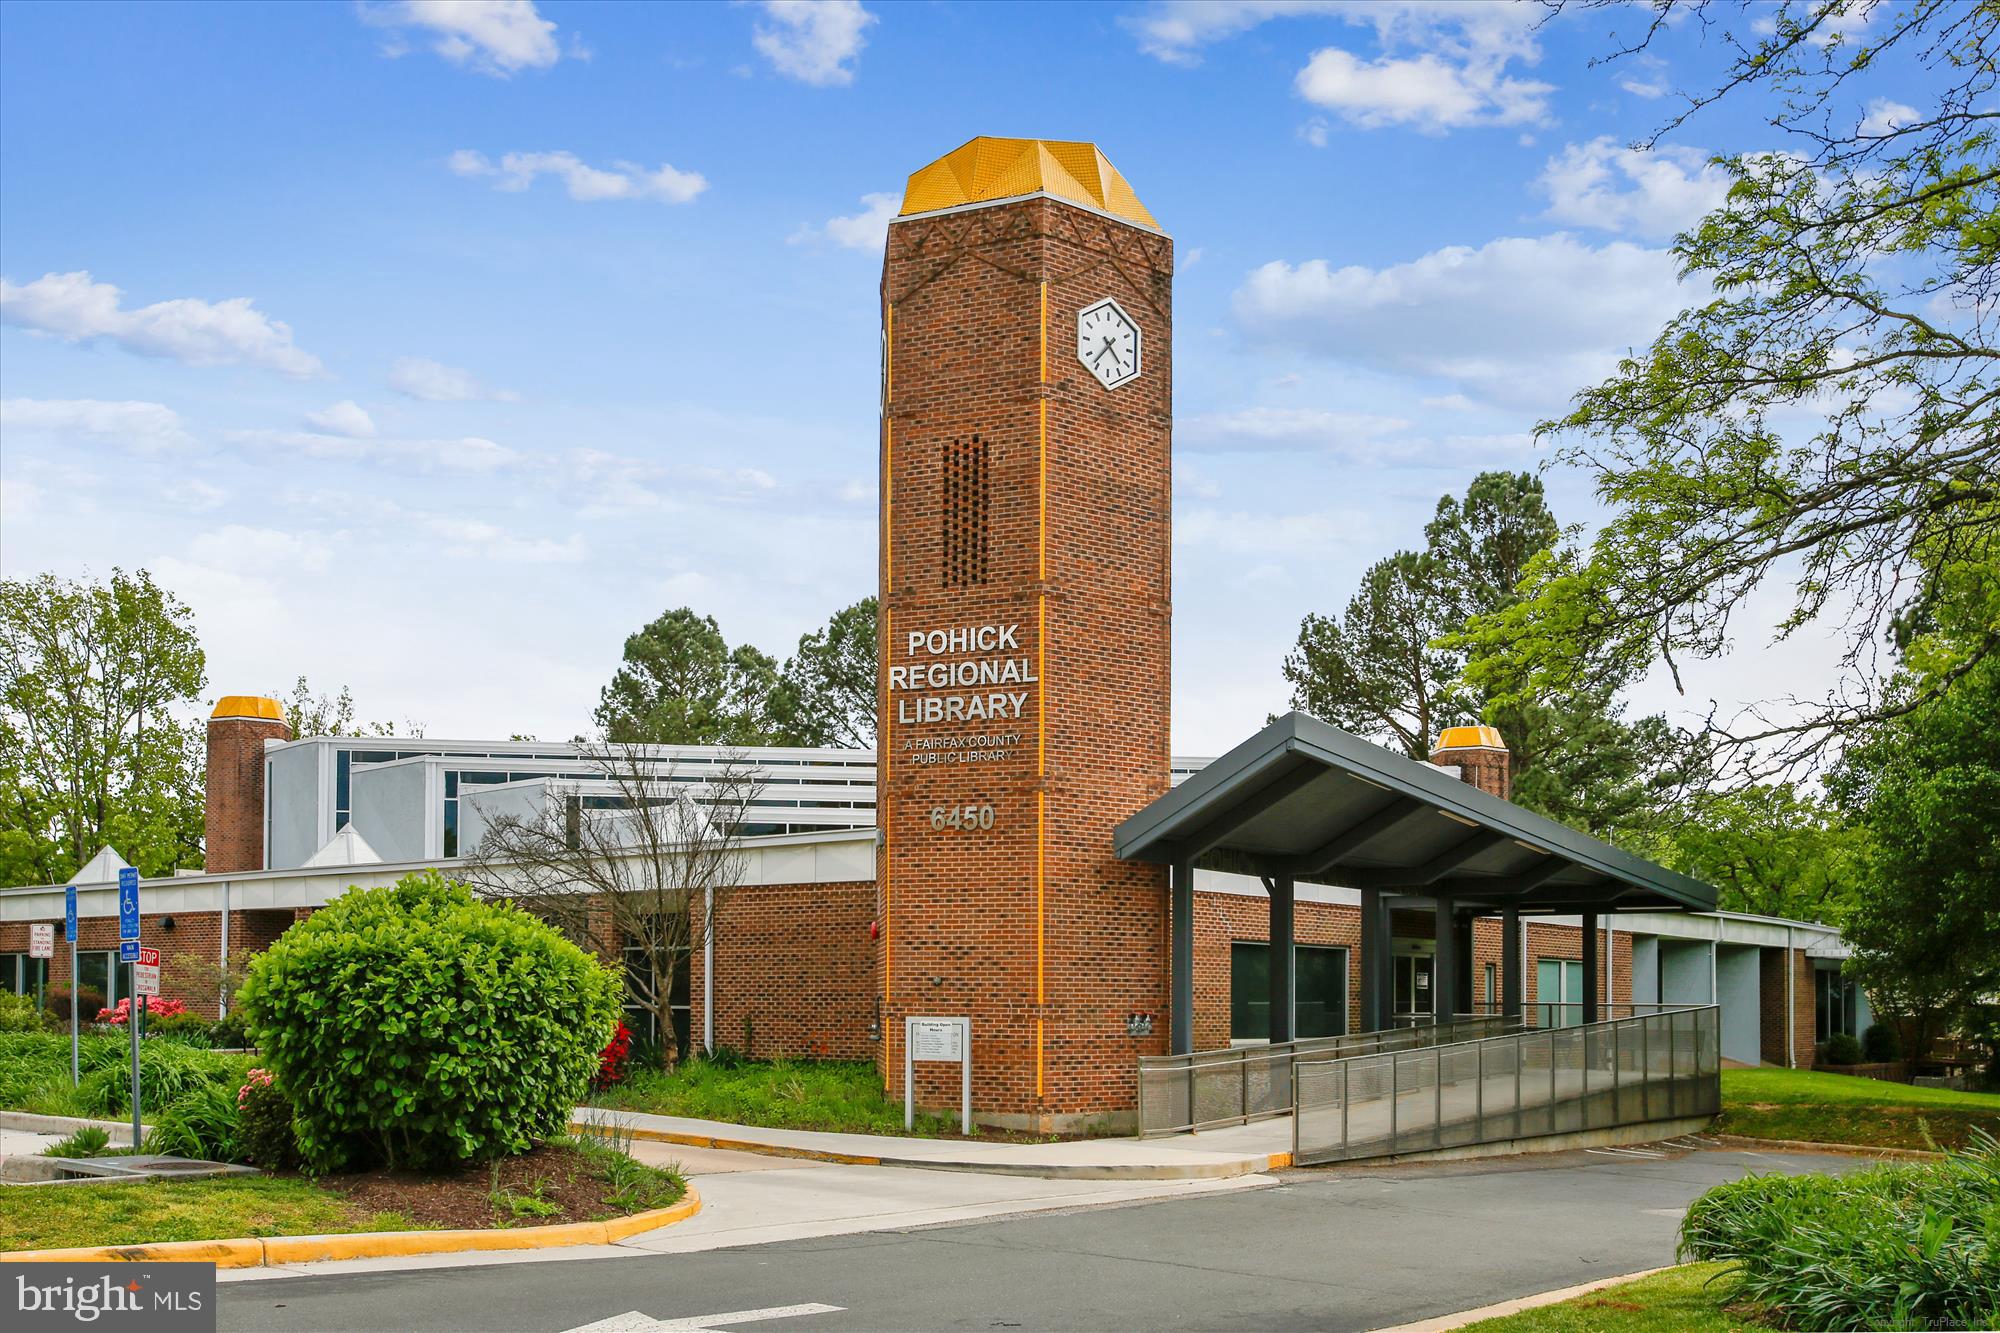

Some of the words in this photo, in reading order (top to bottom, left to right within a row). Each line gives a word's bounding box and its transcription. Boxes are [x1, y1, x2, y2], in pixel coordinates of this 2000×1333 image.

[908, 624, 1019, 656] POHICK
[889, 658, 1039, 691] REGIONAL
[898, 692, 1029, 724] LIBRARY
[904, 740, 913, 751] A
[915, 737, 966, 750] FAIRFAX
[968, 734, 1021, 748] COUNTY
[912, 751, 957, 765] PUBLIC
[959, 750, 1013, 763] LIBRARY
[929, 804, 995, 832] 6450
